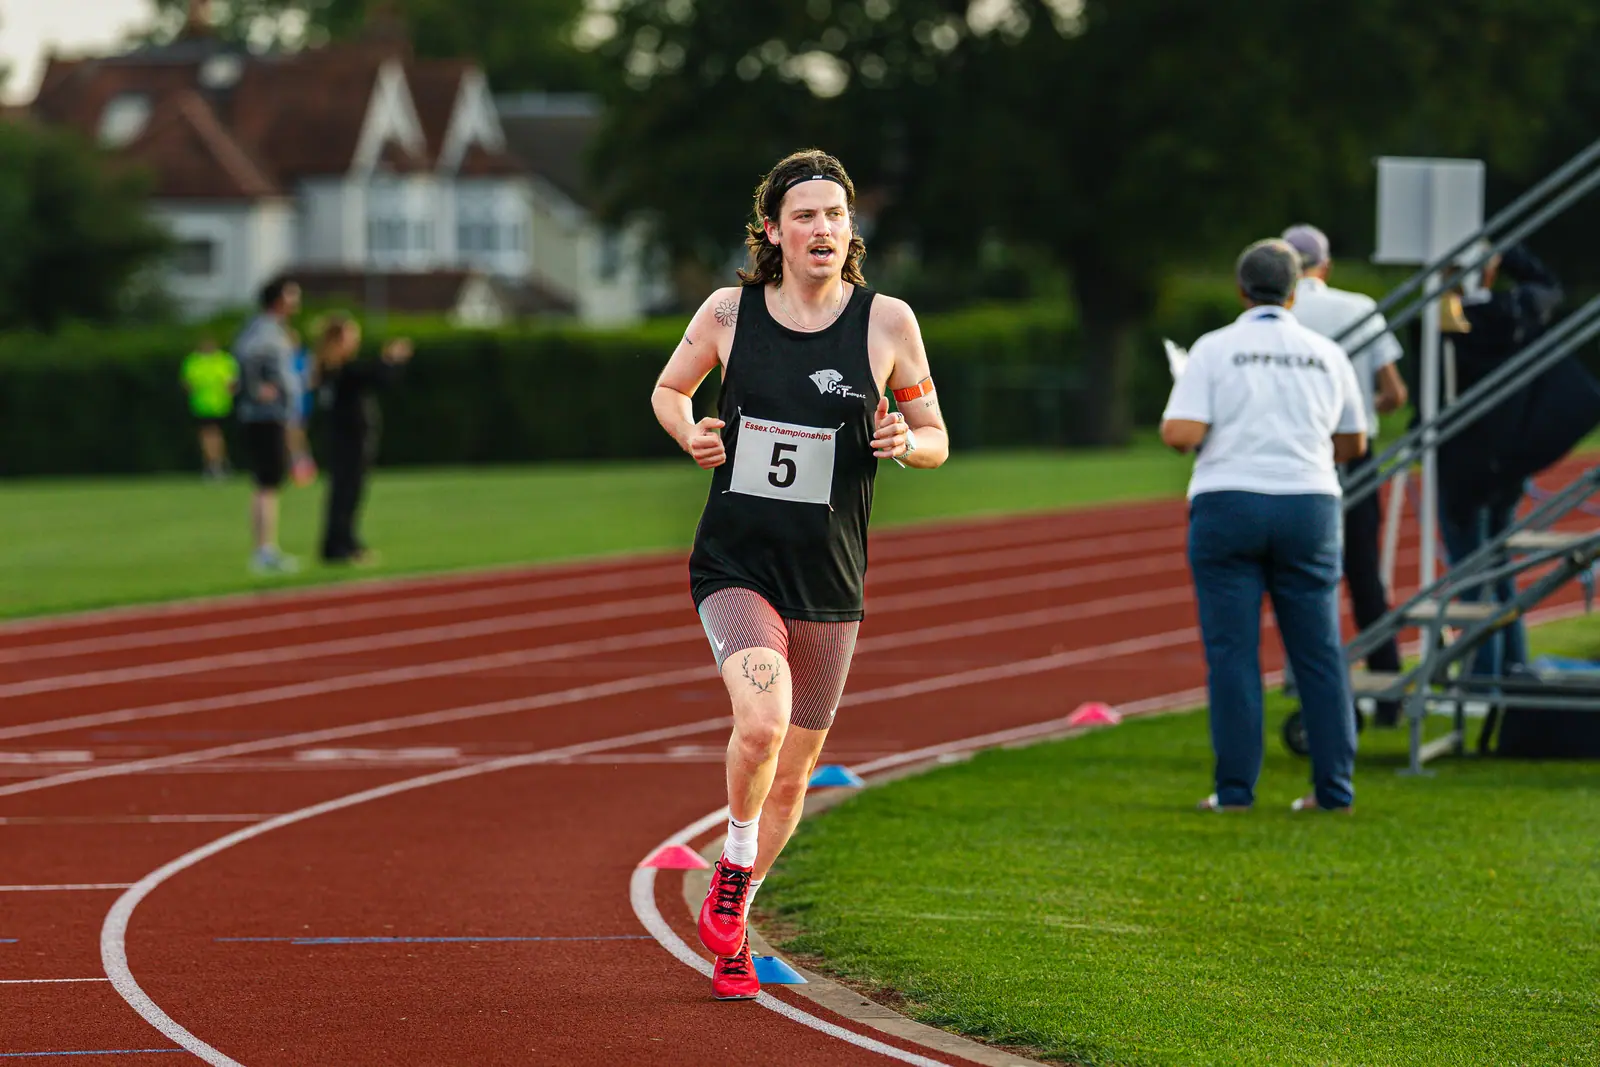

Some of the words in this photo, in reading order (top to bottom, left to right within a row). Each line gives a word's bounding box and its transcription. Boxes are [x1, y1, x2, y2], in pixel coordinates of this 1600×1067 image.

[1232, 352, 1328, 373] OFFICIAL
[744, 421, 768, 432] Essex
[769, 426, 832, 441] Championships
[768, 442, 798, 488] 5
[752, 663, 773, 671] JOY
